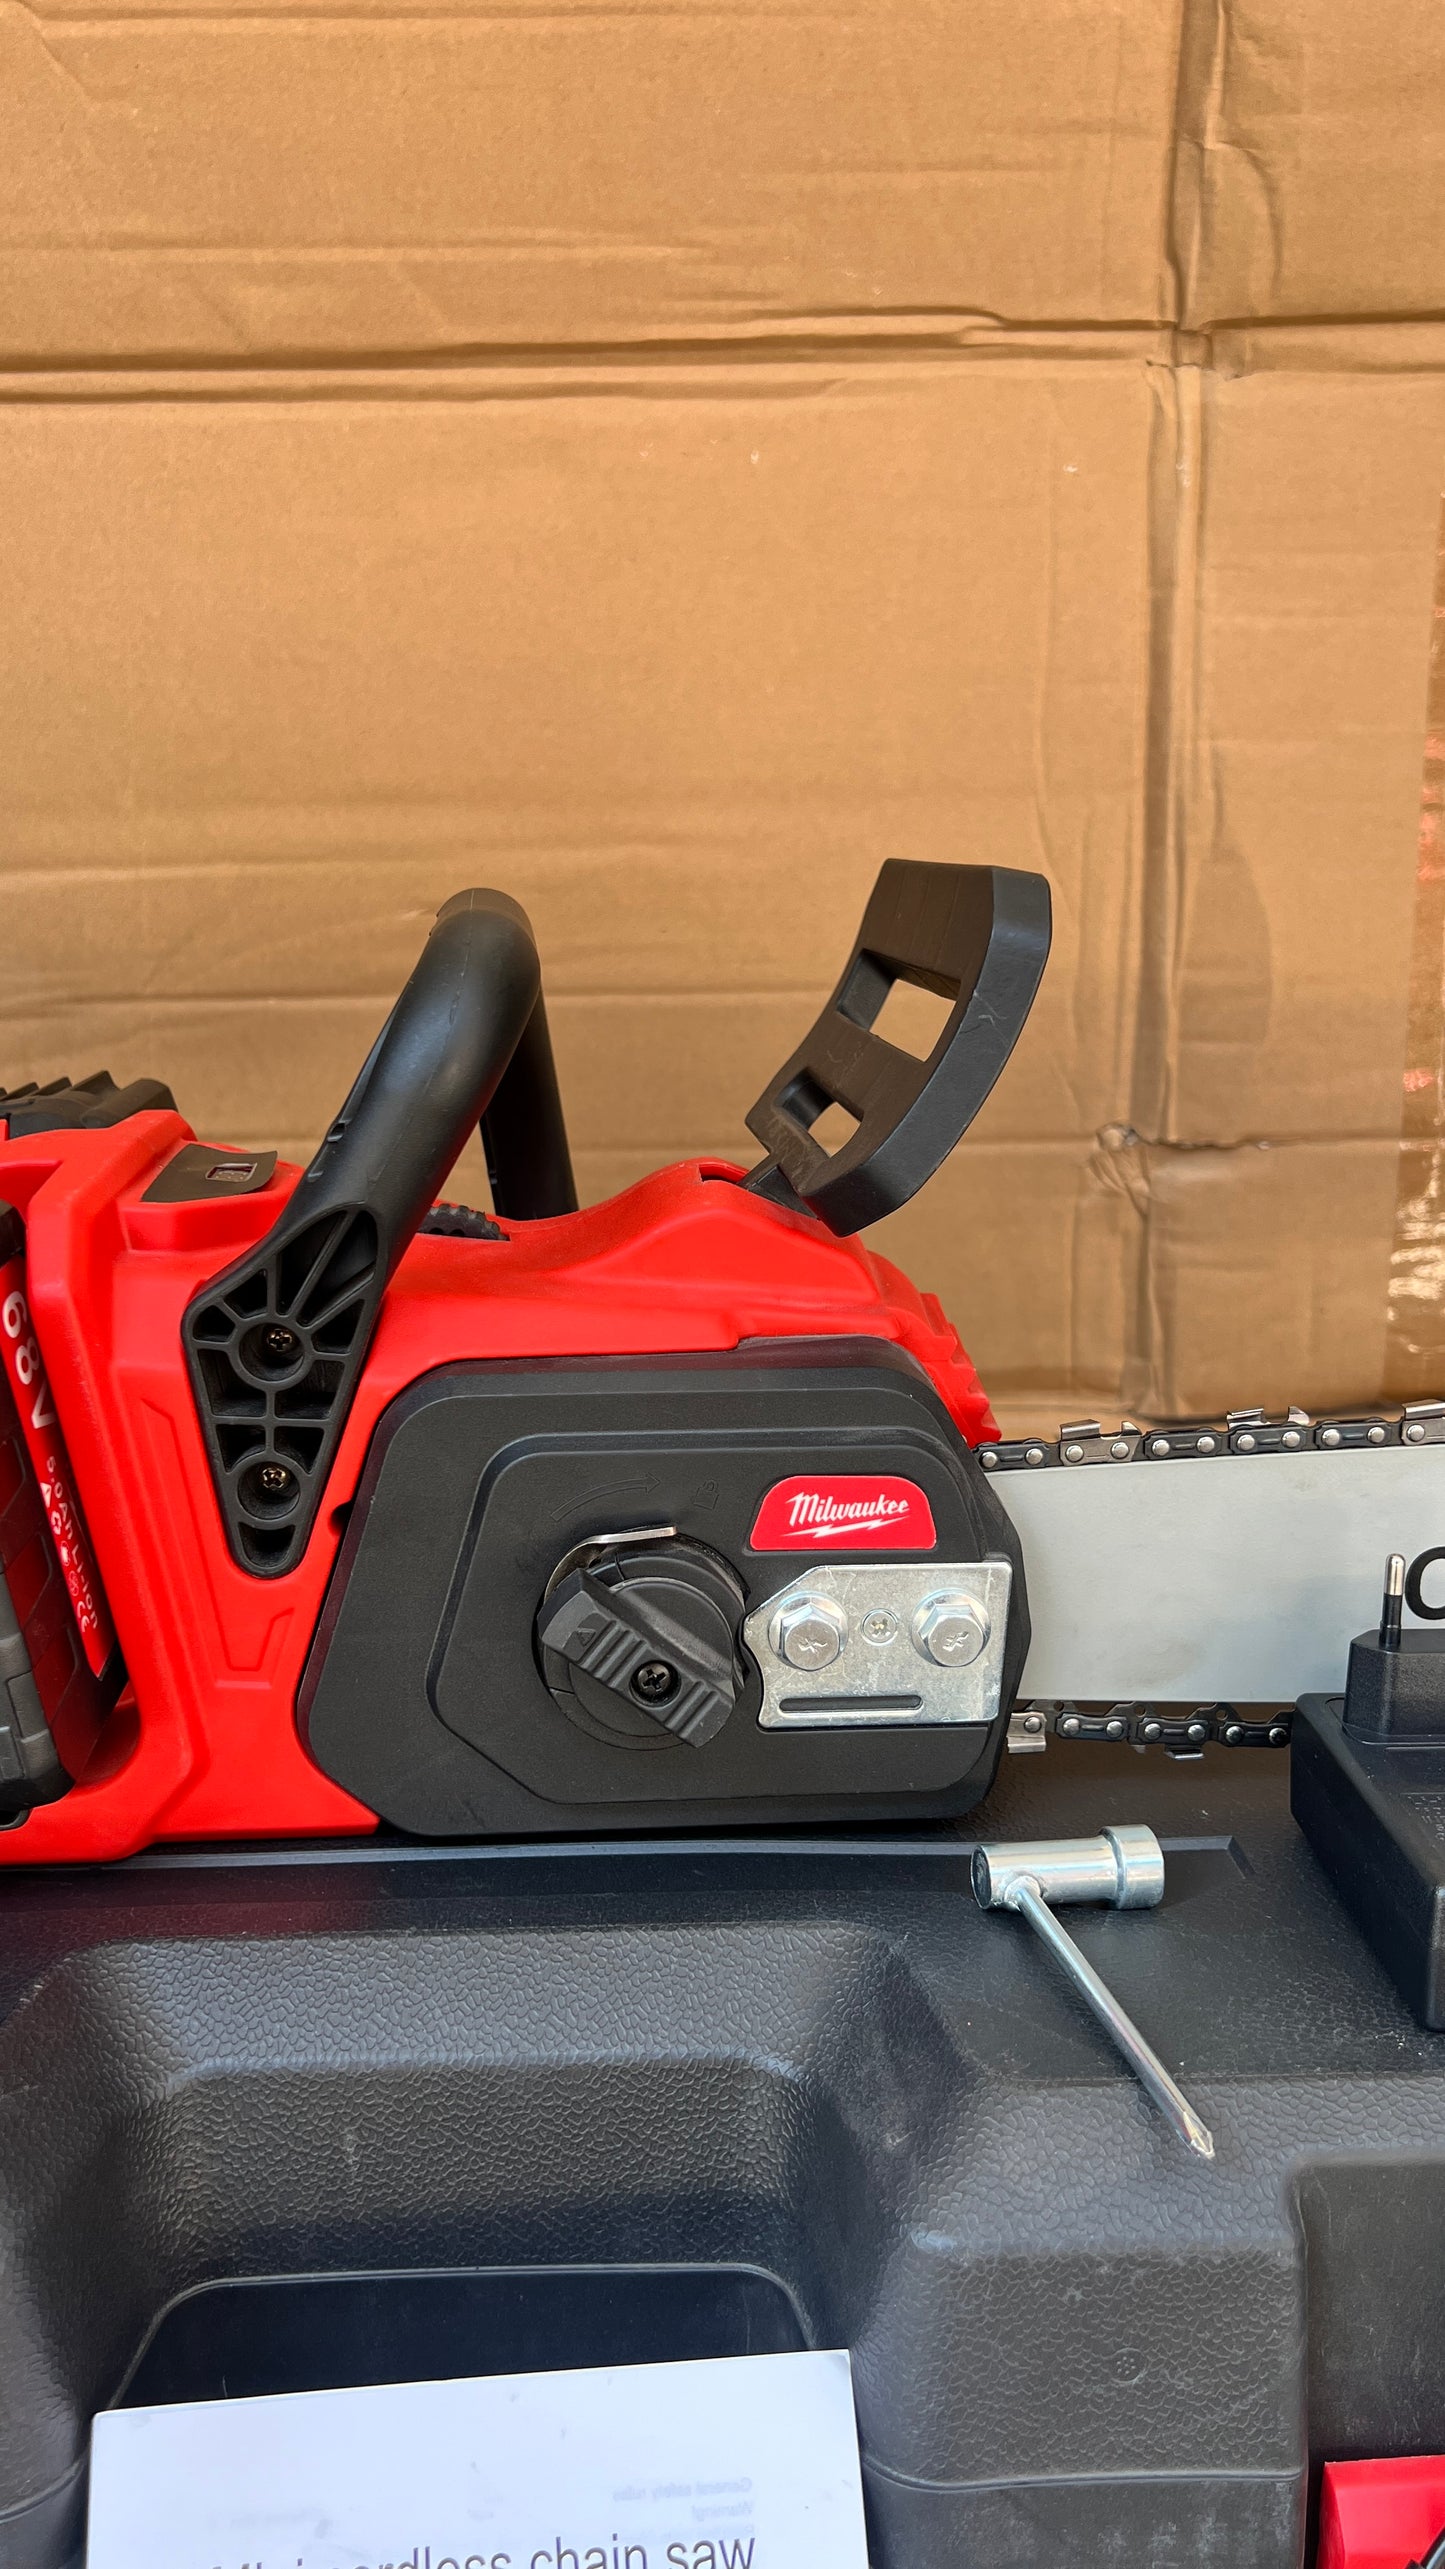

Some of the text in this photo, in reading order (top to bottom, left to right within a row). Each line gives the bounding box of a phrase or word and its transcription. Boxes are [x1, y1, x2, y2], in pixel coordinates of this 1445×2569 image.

[2, 1290, 57, 1430] 68V
[784, 1491, 910, 1527] Milwaukee
[667, 2537, 756, 2569] saw
